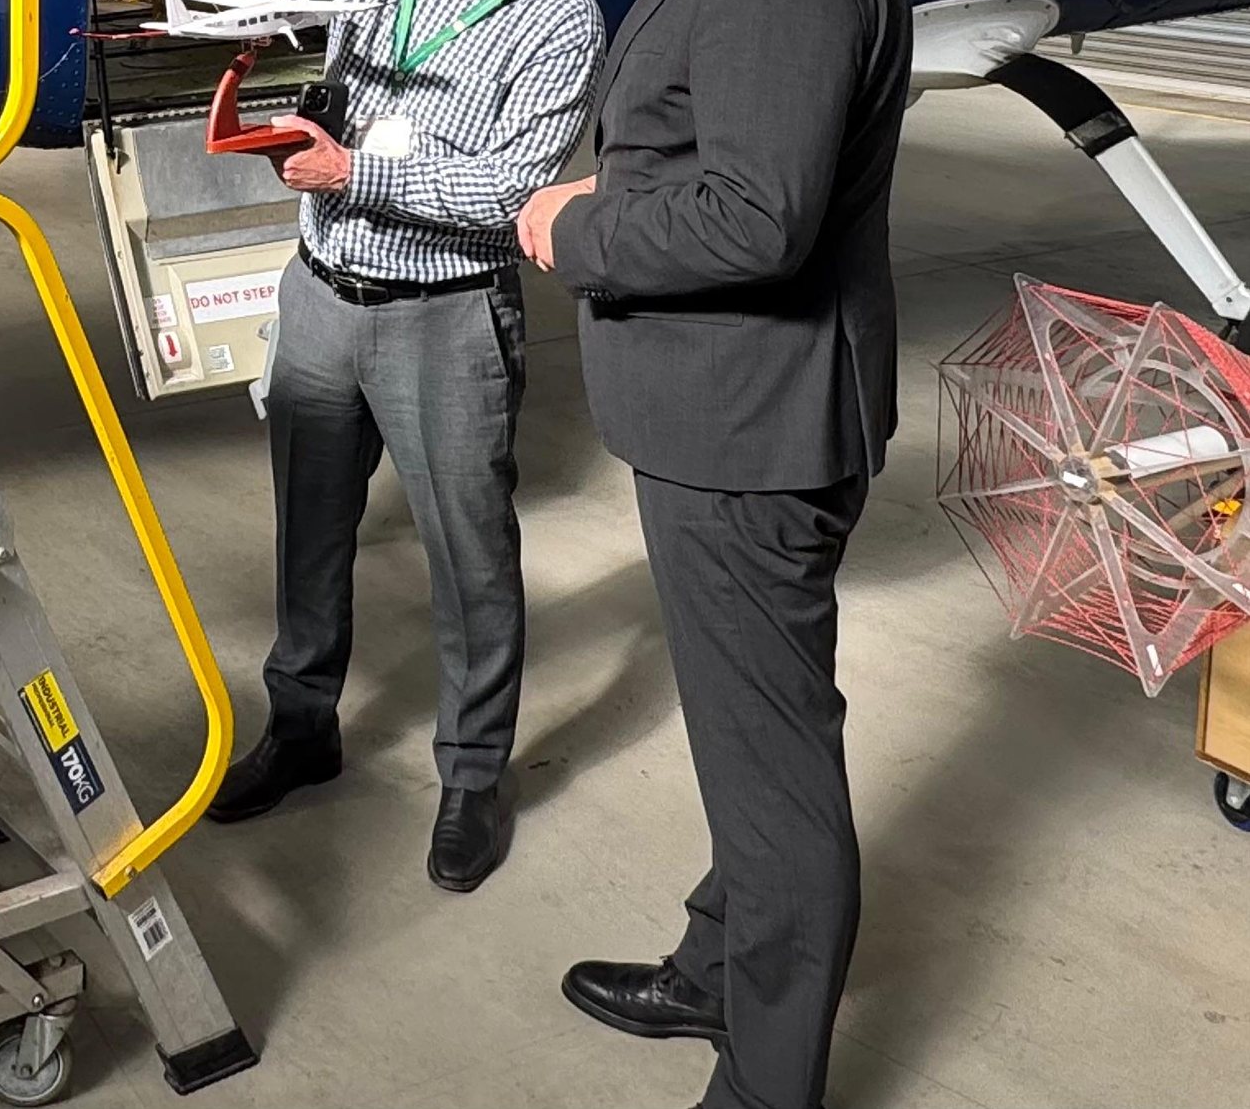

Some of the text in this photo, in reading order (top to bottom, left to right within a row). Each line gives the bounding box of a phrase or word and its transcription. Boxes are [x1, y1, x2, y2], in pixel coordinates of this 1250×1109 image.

[190, 286, 275, 309] DO NOT STEP
[38, 675, 71, 739] INDUSTRIAL
[60, 746, 94, 804] 170KG
